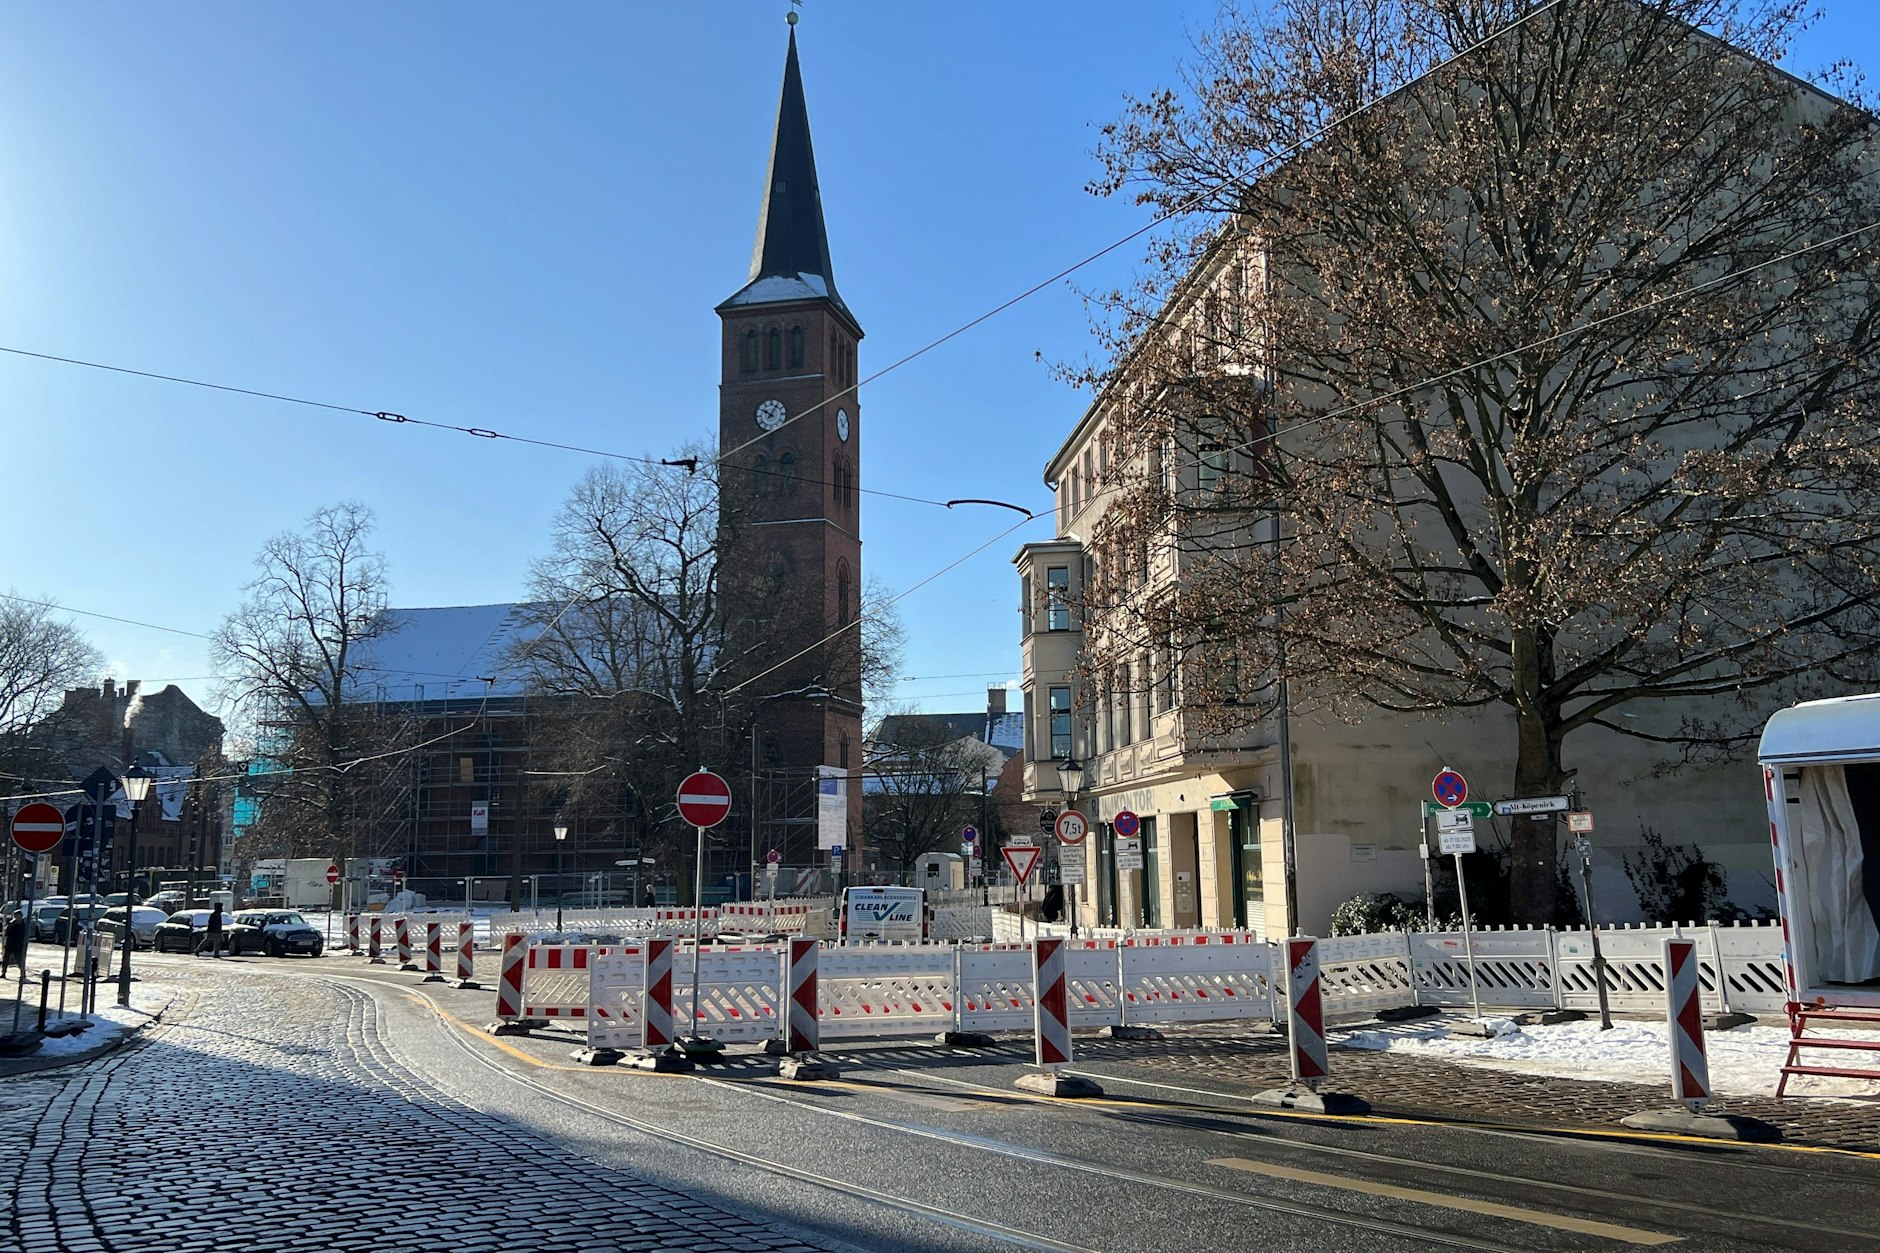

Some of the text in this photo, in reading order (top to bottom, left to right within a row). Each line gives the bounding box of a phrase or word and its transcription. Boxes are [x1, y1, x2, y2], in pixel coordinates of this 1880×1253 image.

[1091, 789, 1153, 817] RUMKONTOR
[1510, 801, 1556, 810] Alt-Köpenick
[855, 903, 889, 911] CLEAN
[889, 914, 913, 922] LINE
